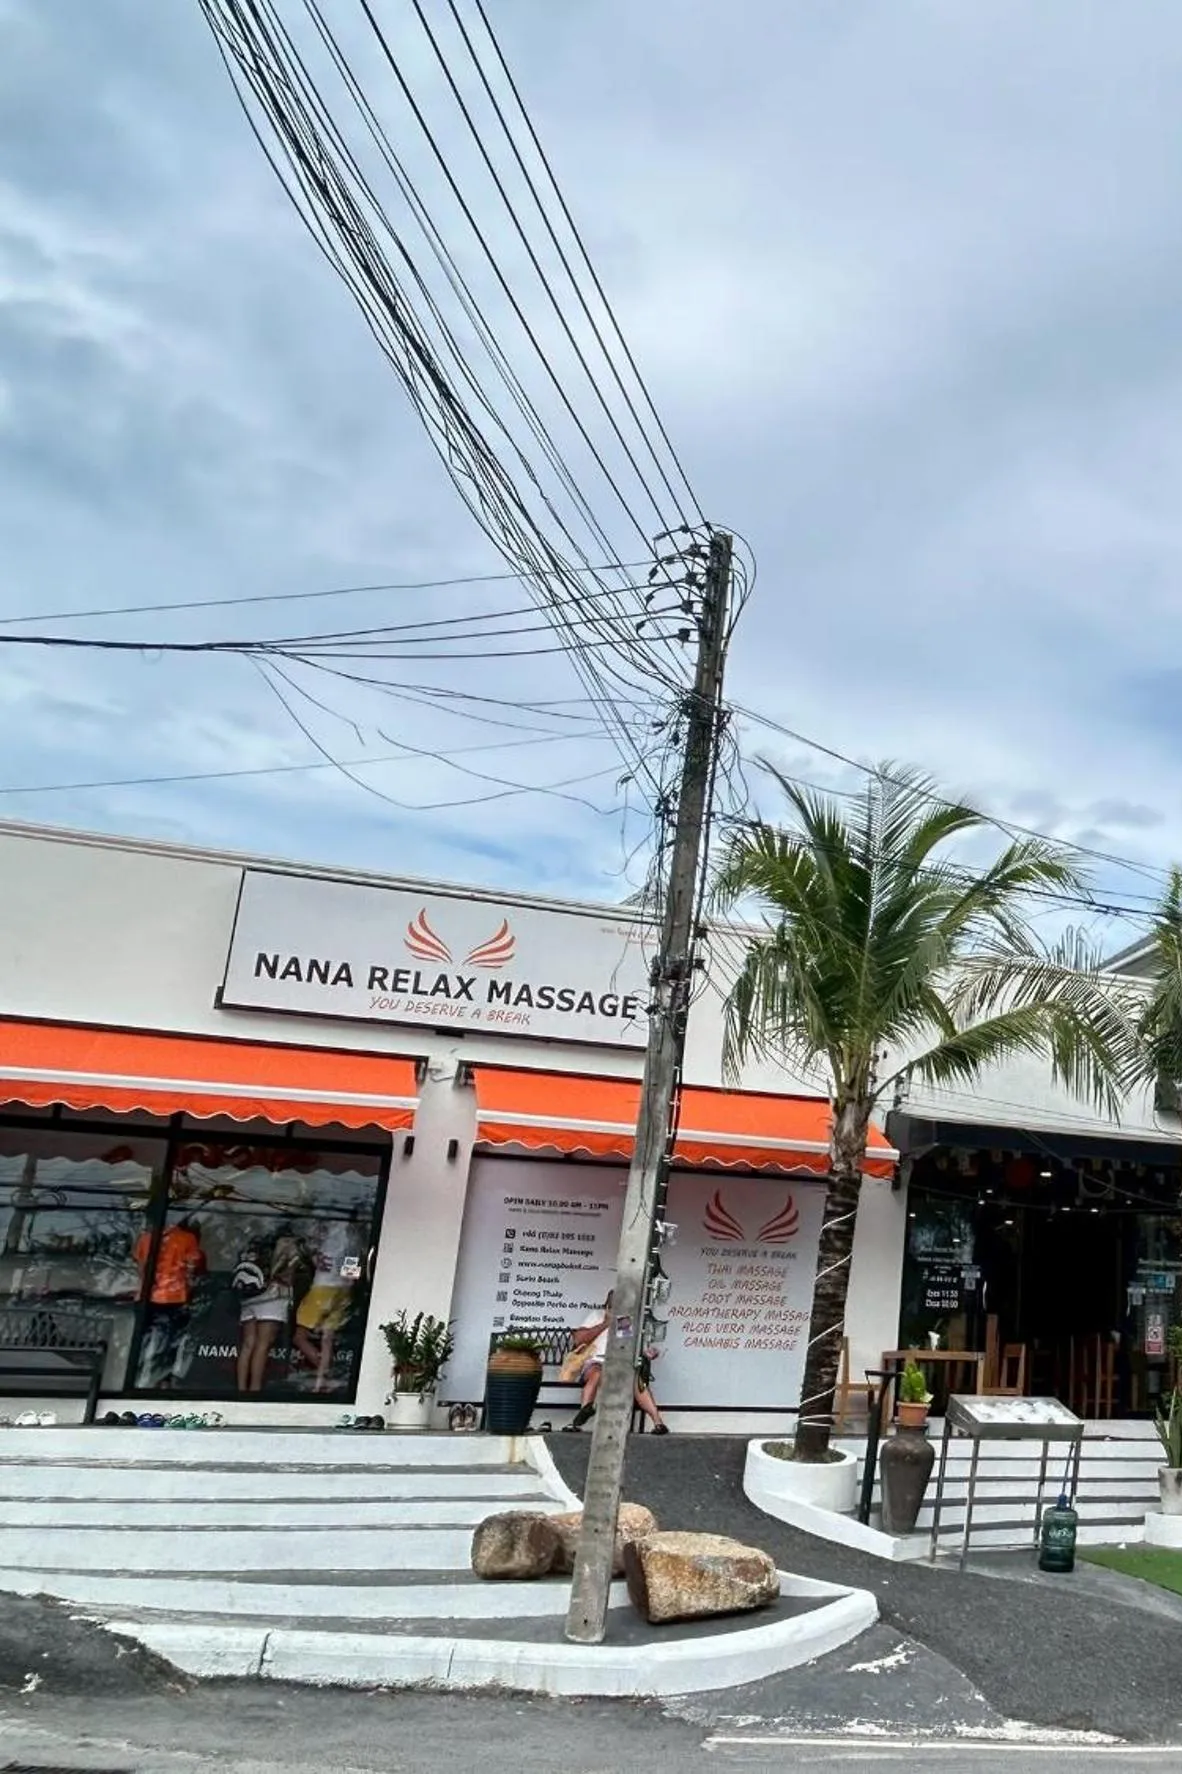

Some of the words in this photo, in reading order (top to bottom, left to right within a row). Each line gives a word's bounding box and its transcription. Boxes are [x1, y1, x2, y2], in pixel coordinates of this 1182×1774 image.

[254, 952, 353, 988] NANA
[367, 964, 477, 1001] RELAX
[487, 980, 638, 1020] MASSAGE
[369, 996, 400, 1011] YOU
[404, 1001, 468, 1018] DESERVE
[470, 1008, 481, 1020] A
[486, 1010, 531, 1026] BREAK
[707, 1263, 732, 1275] THAI
[736, 1264, 789, 1279] MASSAGE
[730, 1279, 785, 1292] MASSAGE
[702, 1292, 732, 1304] FOOT
[735, 1294, 788, 1307] MASSAGE
[668, 1306, 762, 1321] AROMATHERAPY
[764, 1310, 810, 1321] MASSAG
[682, 1321, 712, 1333] ALOE
[715, 1322, 746, 1334] VERA
[748, 1324, 803, 1336] MASSAGE
[198, 1345, 239, 1358] NANA
[683, 1337, 741, 1349] CANNABIS
[743, 1339, 798, 1351] MASSAGE
